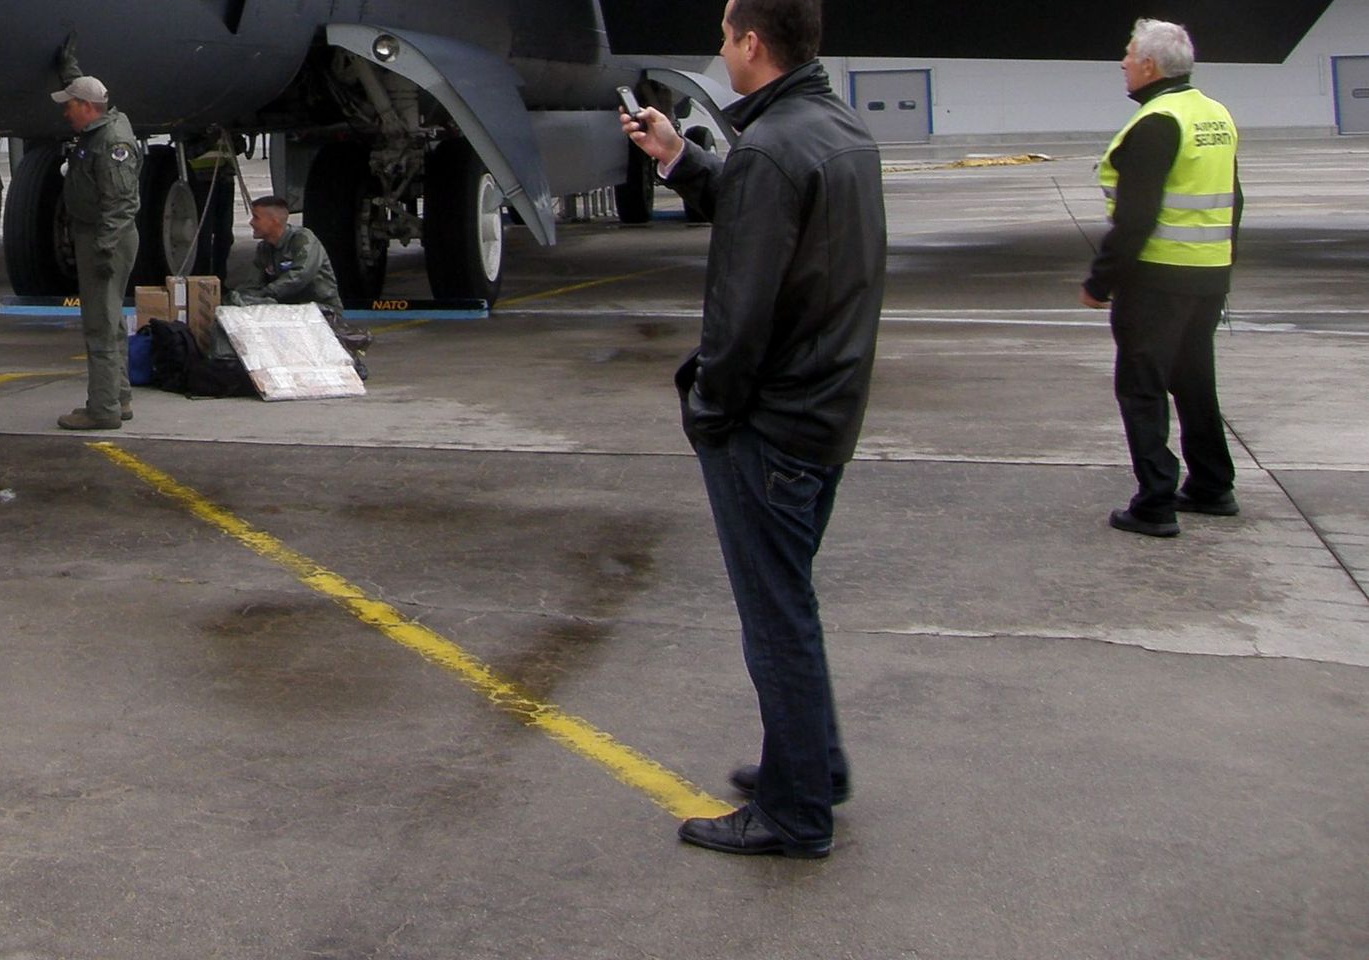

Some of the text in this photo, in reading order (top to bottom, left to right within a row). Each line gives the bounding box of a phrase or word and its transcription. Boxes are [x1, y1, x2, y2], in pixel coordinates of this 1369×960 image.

[1194, 121, 1227, 131] AIRPORT
[1195, 133, 1232, 146] SECURITY
[63, 297, 81, 307] NA
[373, 299, 408, 310] NATO
